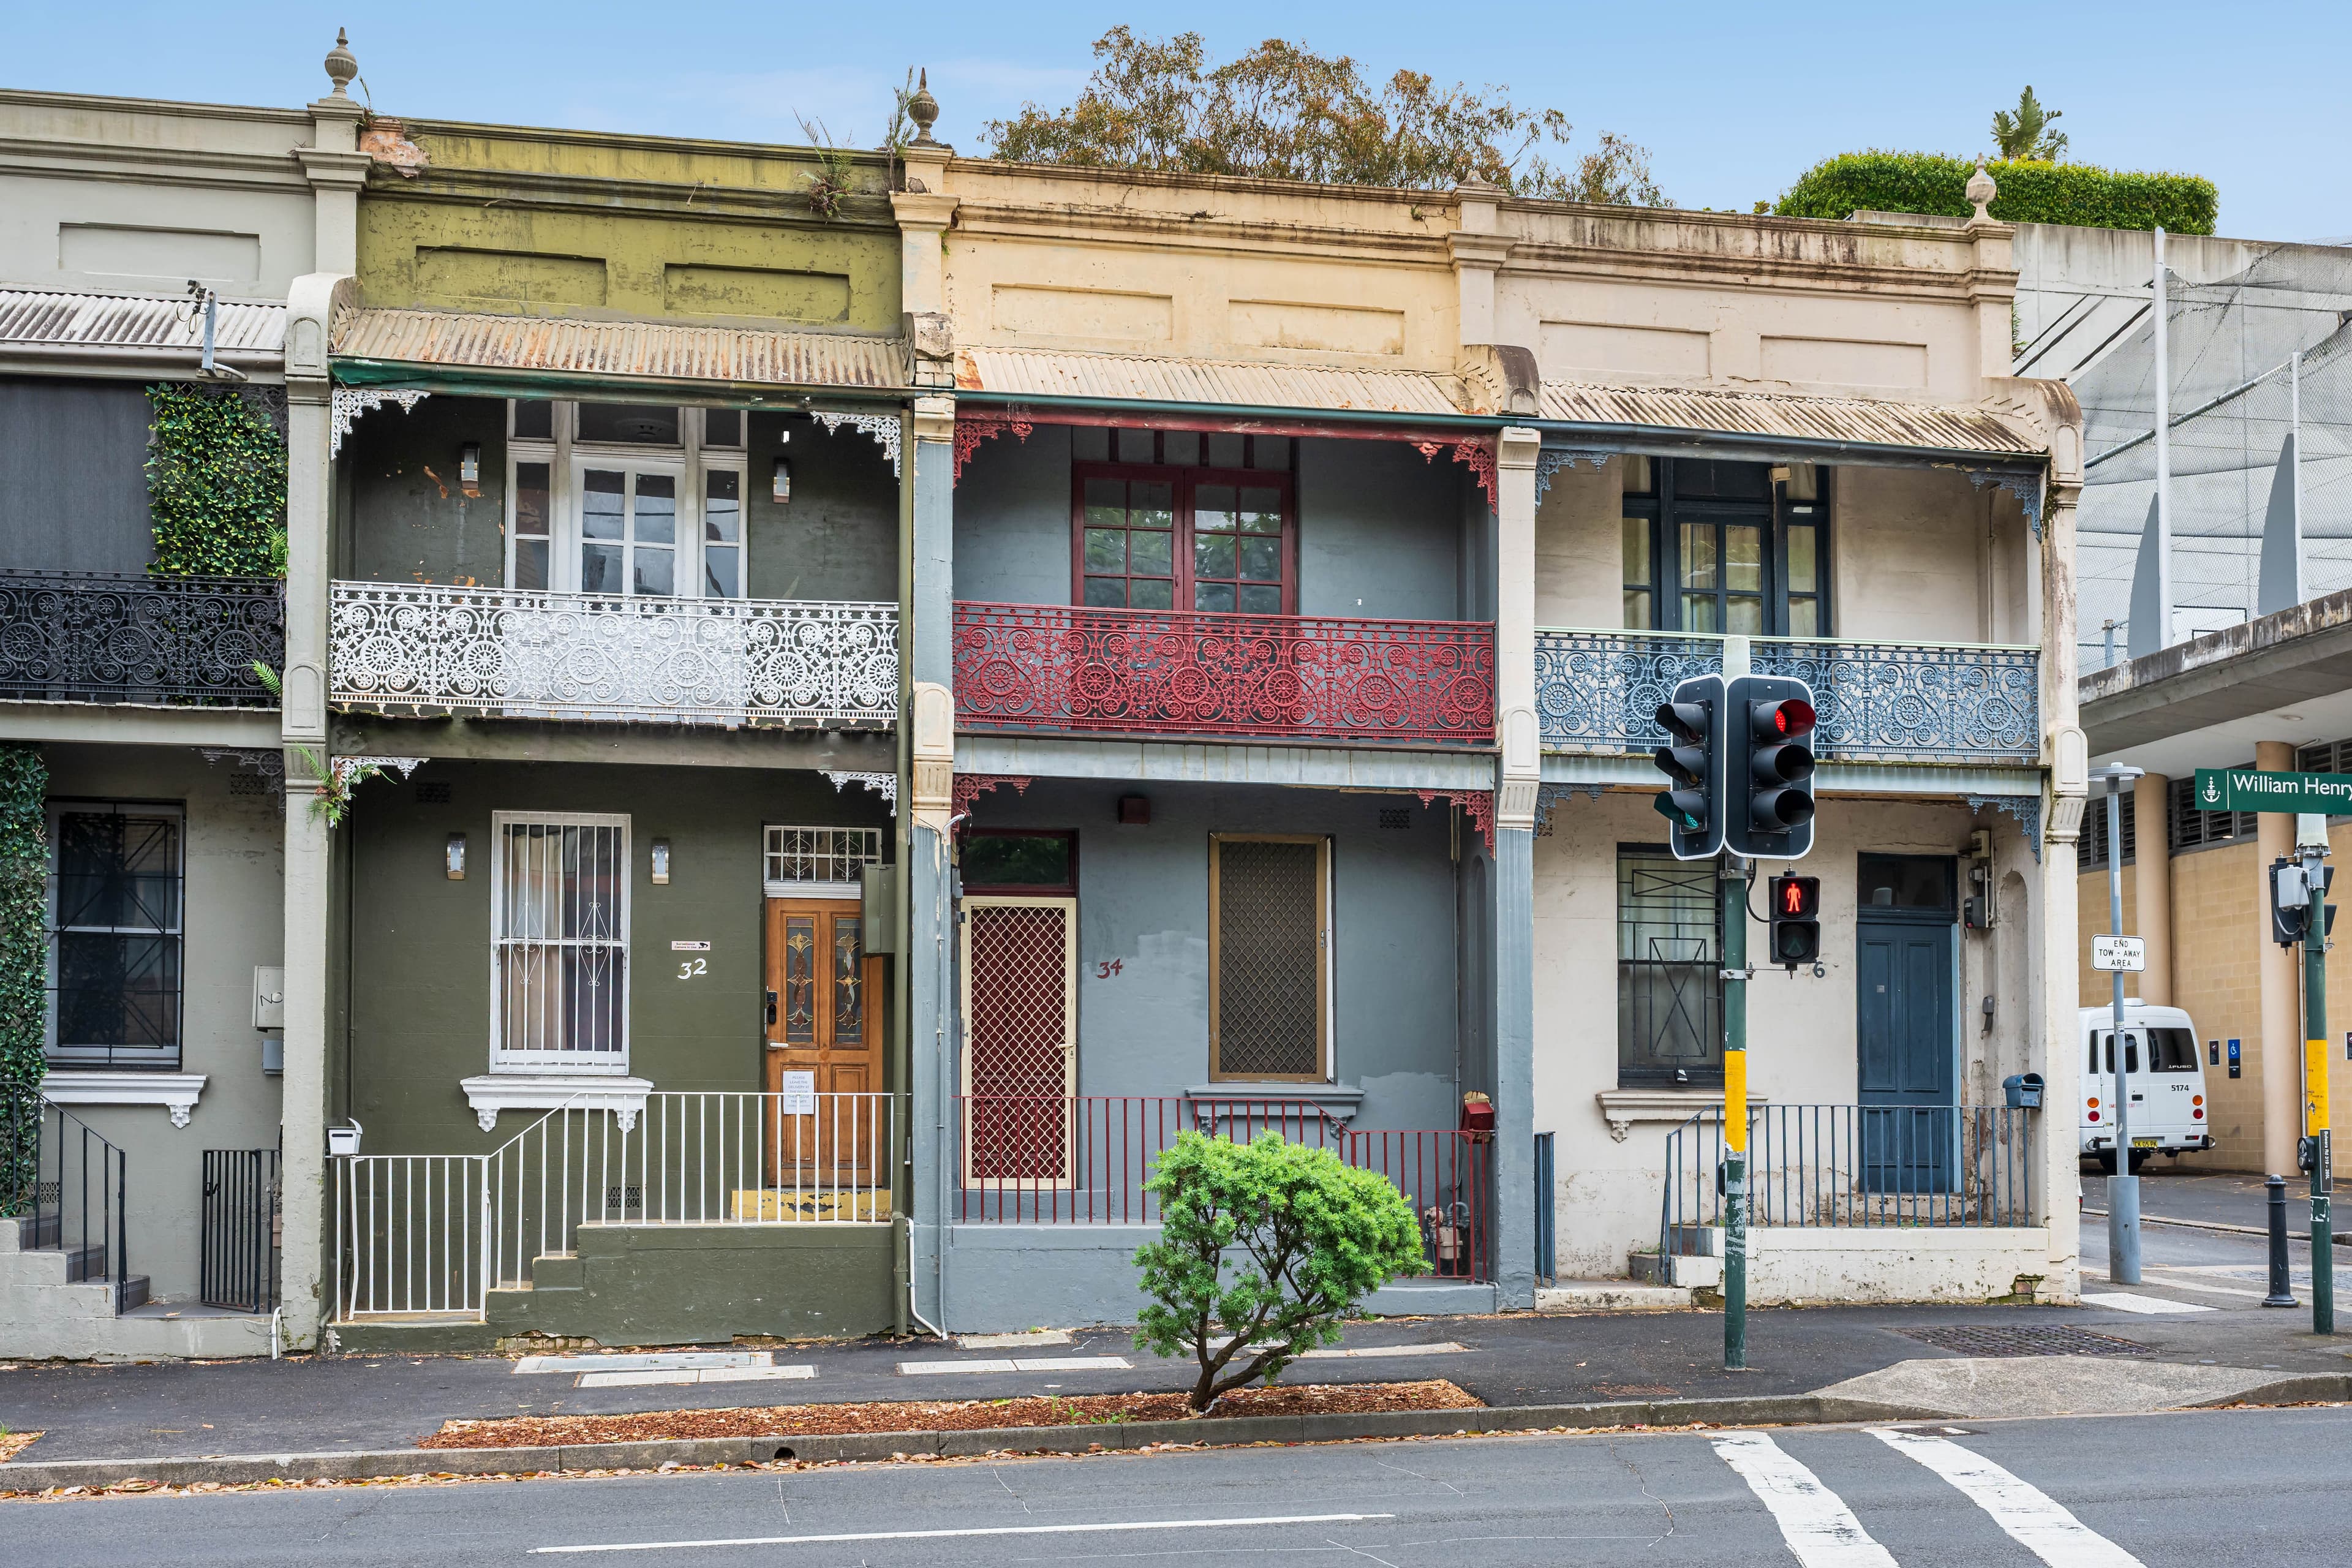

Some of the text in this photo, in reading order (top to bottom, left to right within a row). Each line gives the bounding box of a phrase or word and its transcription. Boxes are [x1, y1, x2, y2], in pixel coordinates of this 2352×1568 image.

[2233, 774, 2352, 801] William Henry
[677, 958, 707, 980] 32
[1097, 958, 1123, 979] 34
[1814, 961, 1825, 978] 6
